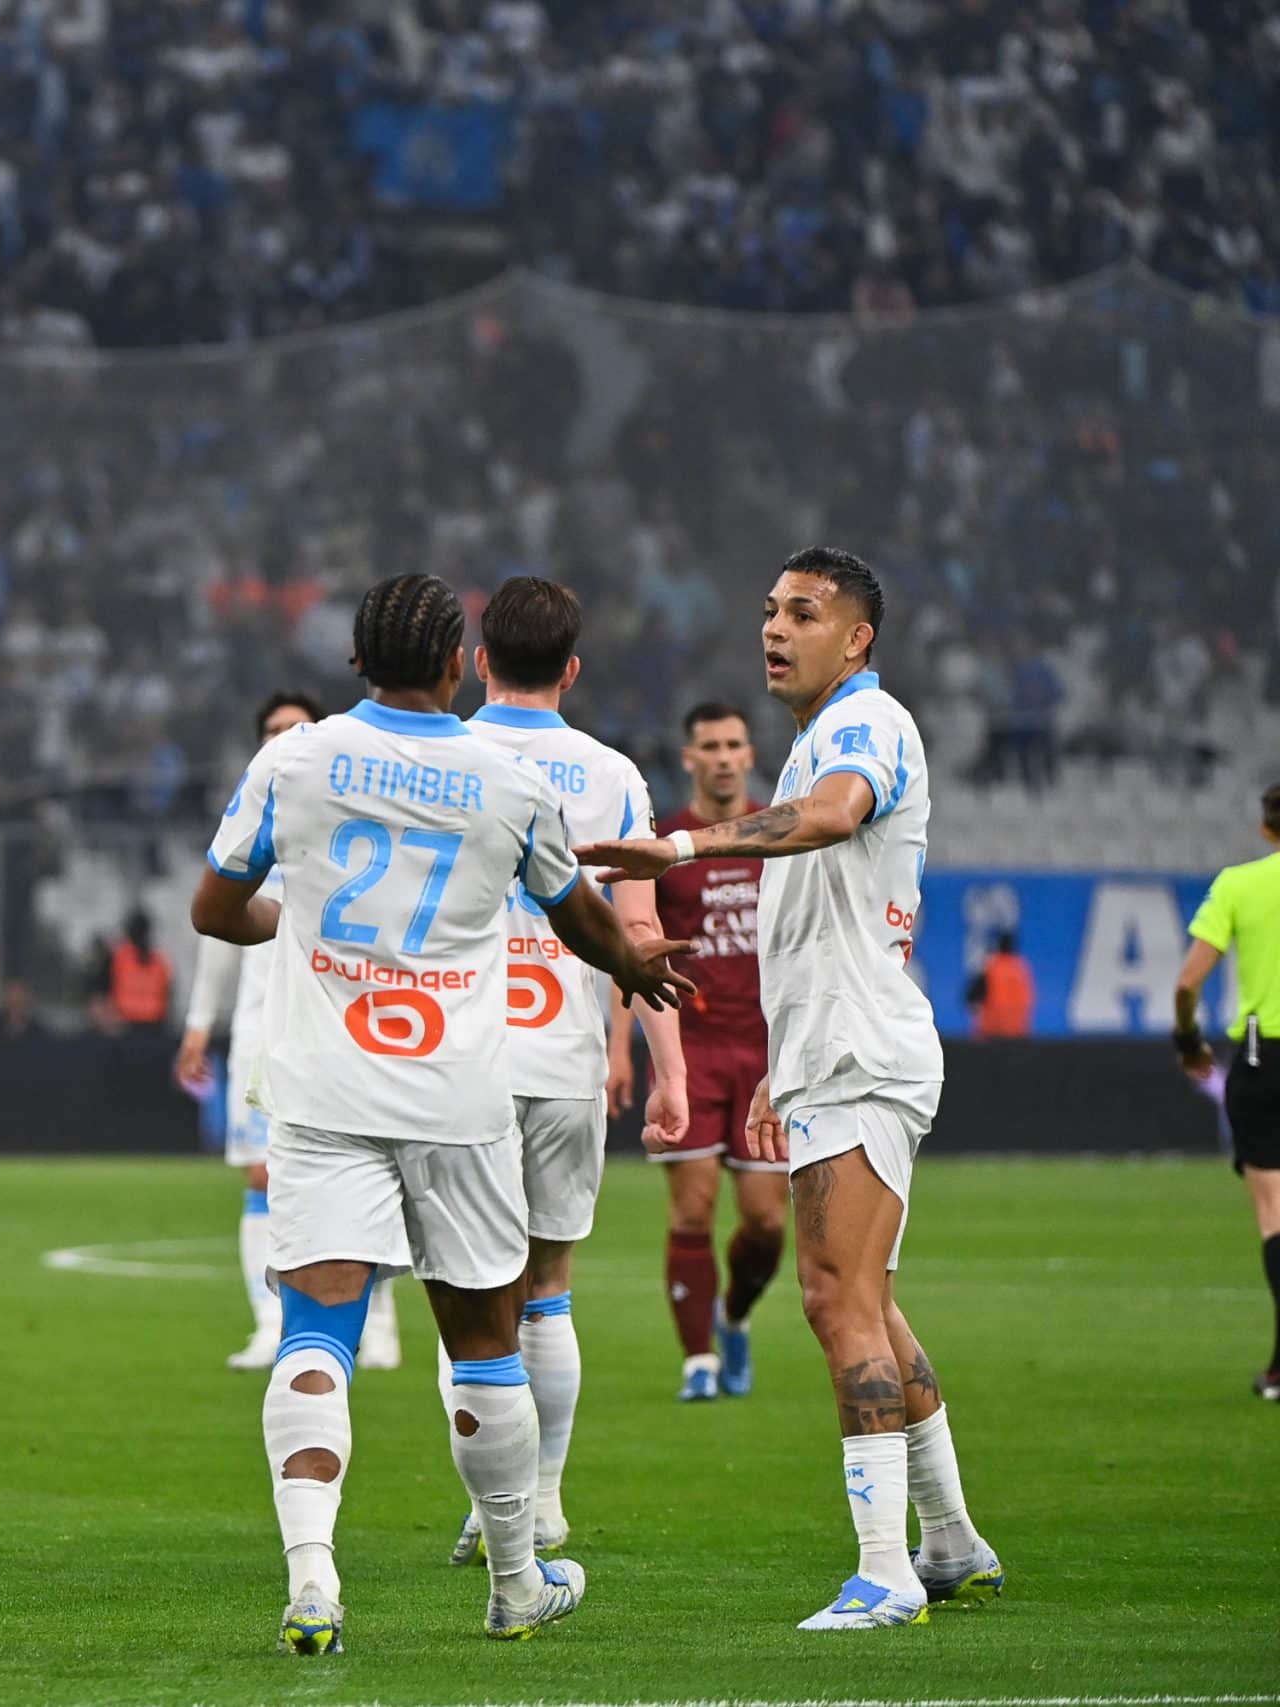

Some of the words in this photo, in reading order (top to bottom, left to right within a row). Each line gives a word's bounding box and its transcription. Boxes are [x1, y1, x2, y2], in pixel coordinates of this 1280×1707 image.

[330, 754, 483, 811] Q.TIMBER
[320, 818, 464, 954] 27
[311, 949, 476, 991] boulanger
